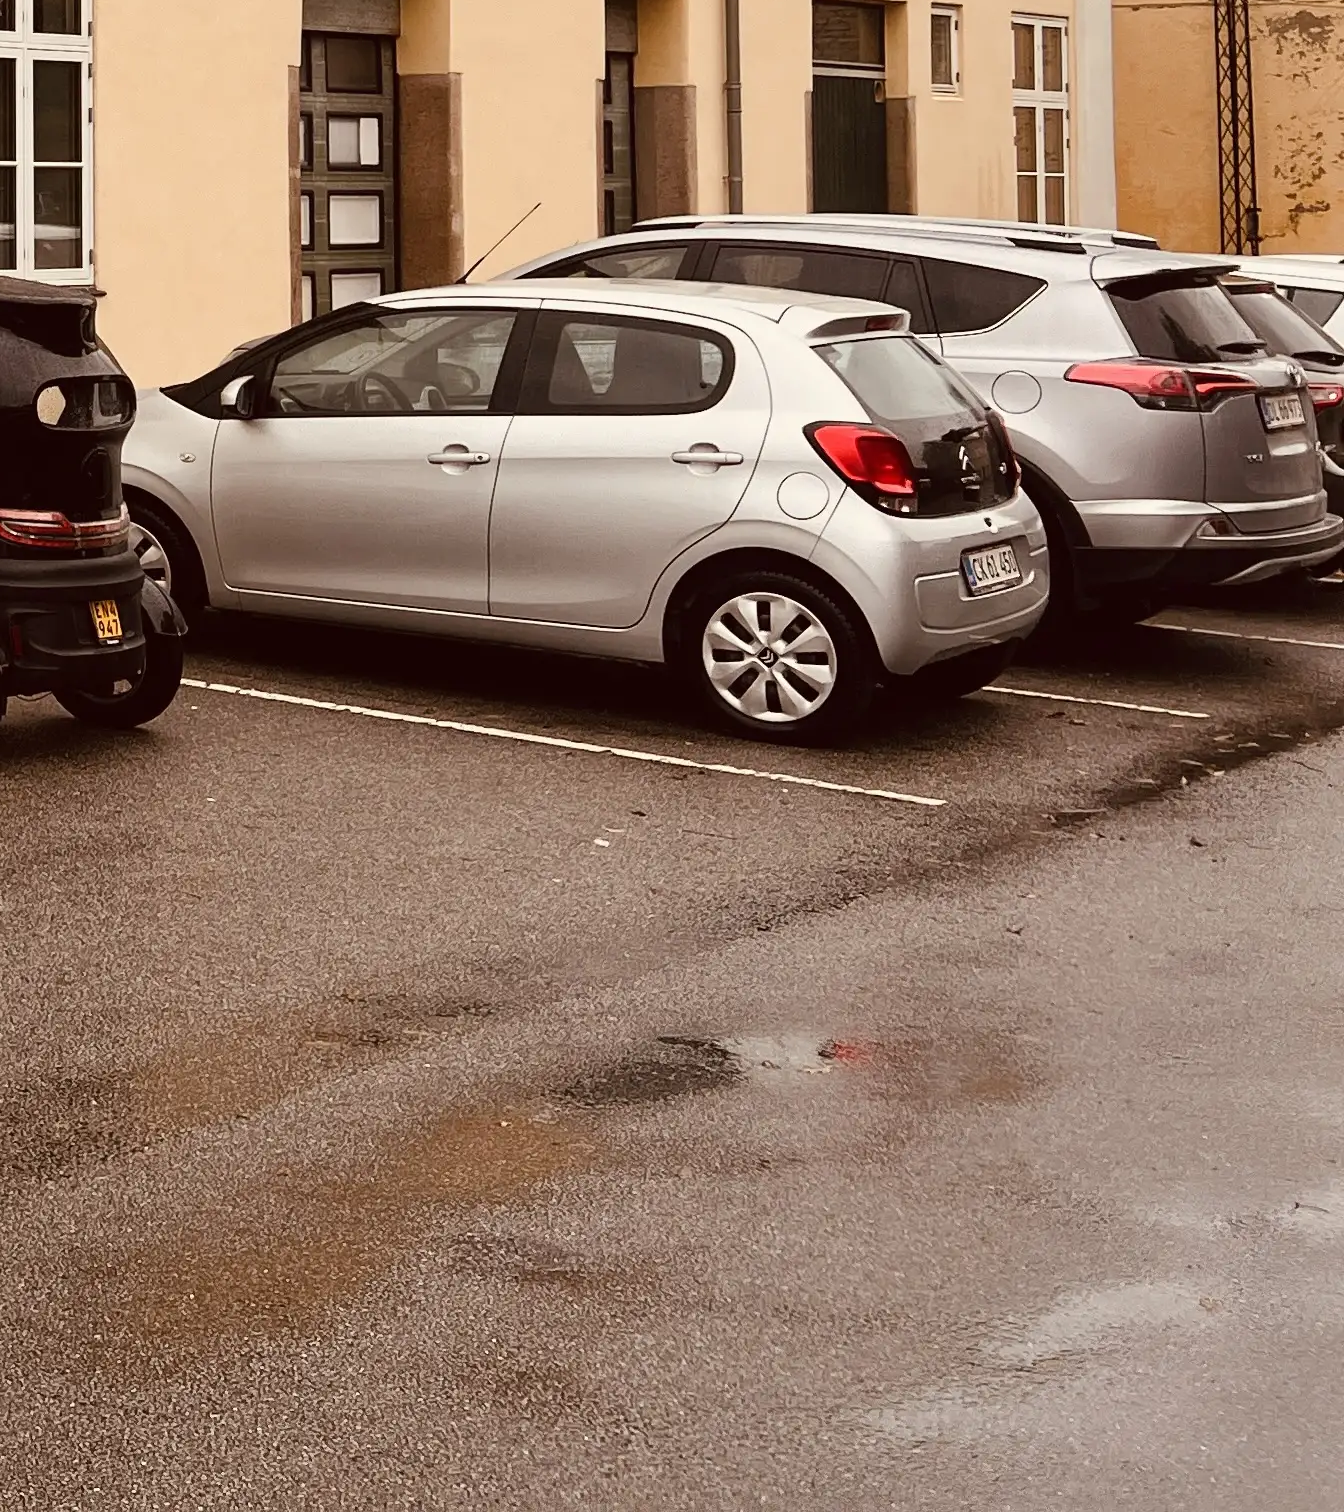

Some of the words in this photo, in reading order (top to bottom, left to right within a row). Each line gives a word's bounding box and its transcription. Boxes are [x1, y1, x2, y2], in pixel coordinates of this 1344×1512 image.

[972, 556, 989, 581] CK
[986, 554, 1000, 578] 61
[998, 549, 1017, 575] 450
[98, 618, 119, 637] 947
